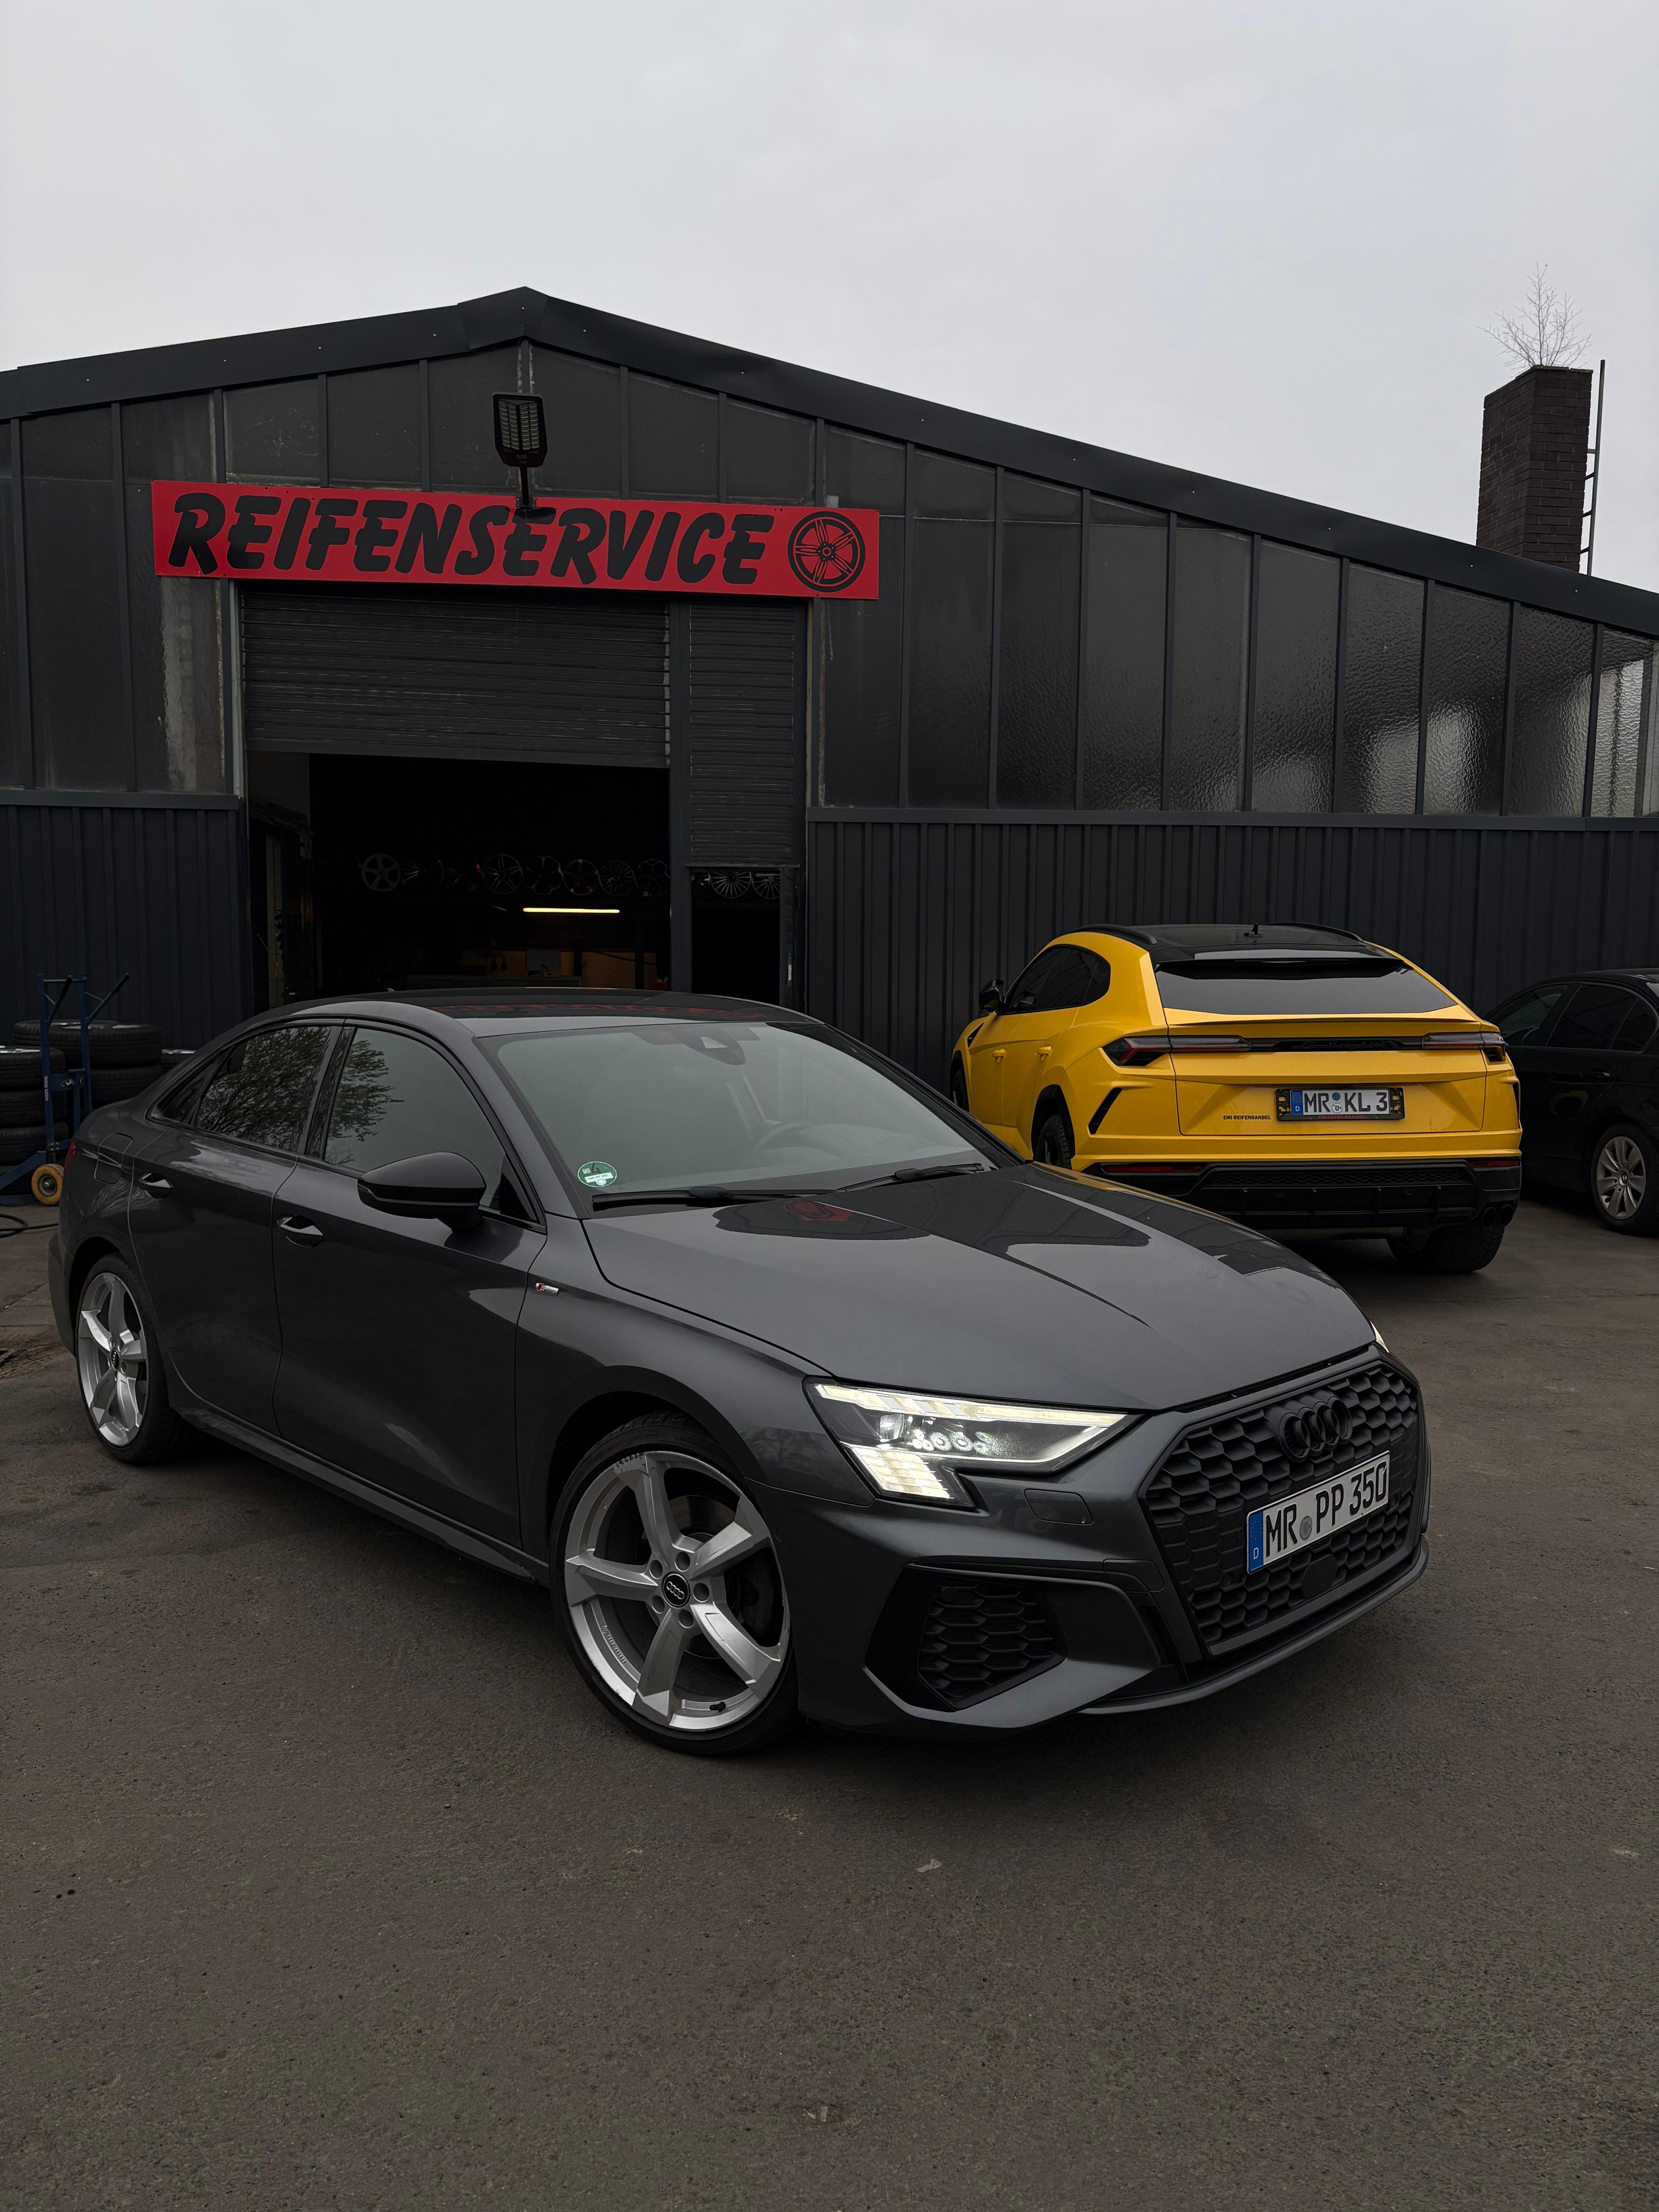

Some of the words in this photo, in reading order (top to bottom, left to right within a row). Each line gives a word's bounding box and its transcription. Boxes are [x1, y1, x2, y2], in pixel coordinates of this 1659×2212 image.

[168, 493, 775, 585] REIFENSERVICE
[1304, 1093, 1330, 1112] MR
[1344, 1092, 1370, 1112] KL
[1376, 1092, 1387, 1112] 3
[1253, 1547, 1259, 1560] D
[1266, 1503, 1298, 1557] MR
[1316, 1483, 1344, 1534] PP
[1349, 1461, 1387, 1516] 350
